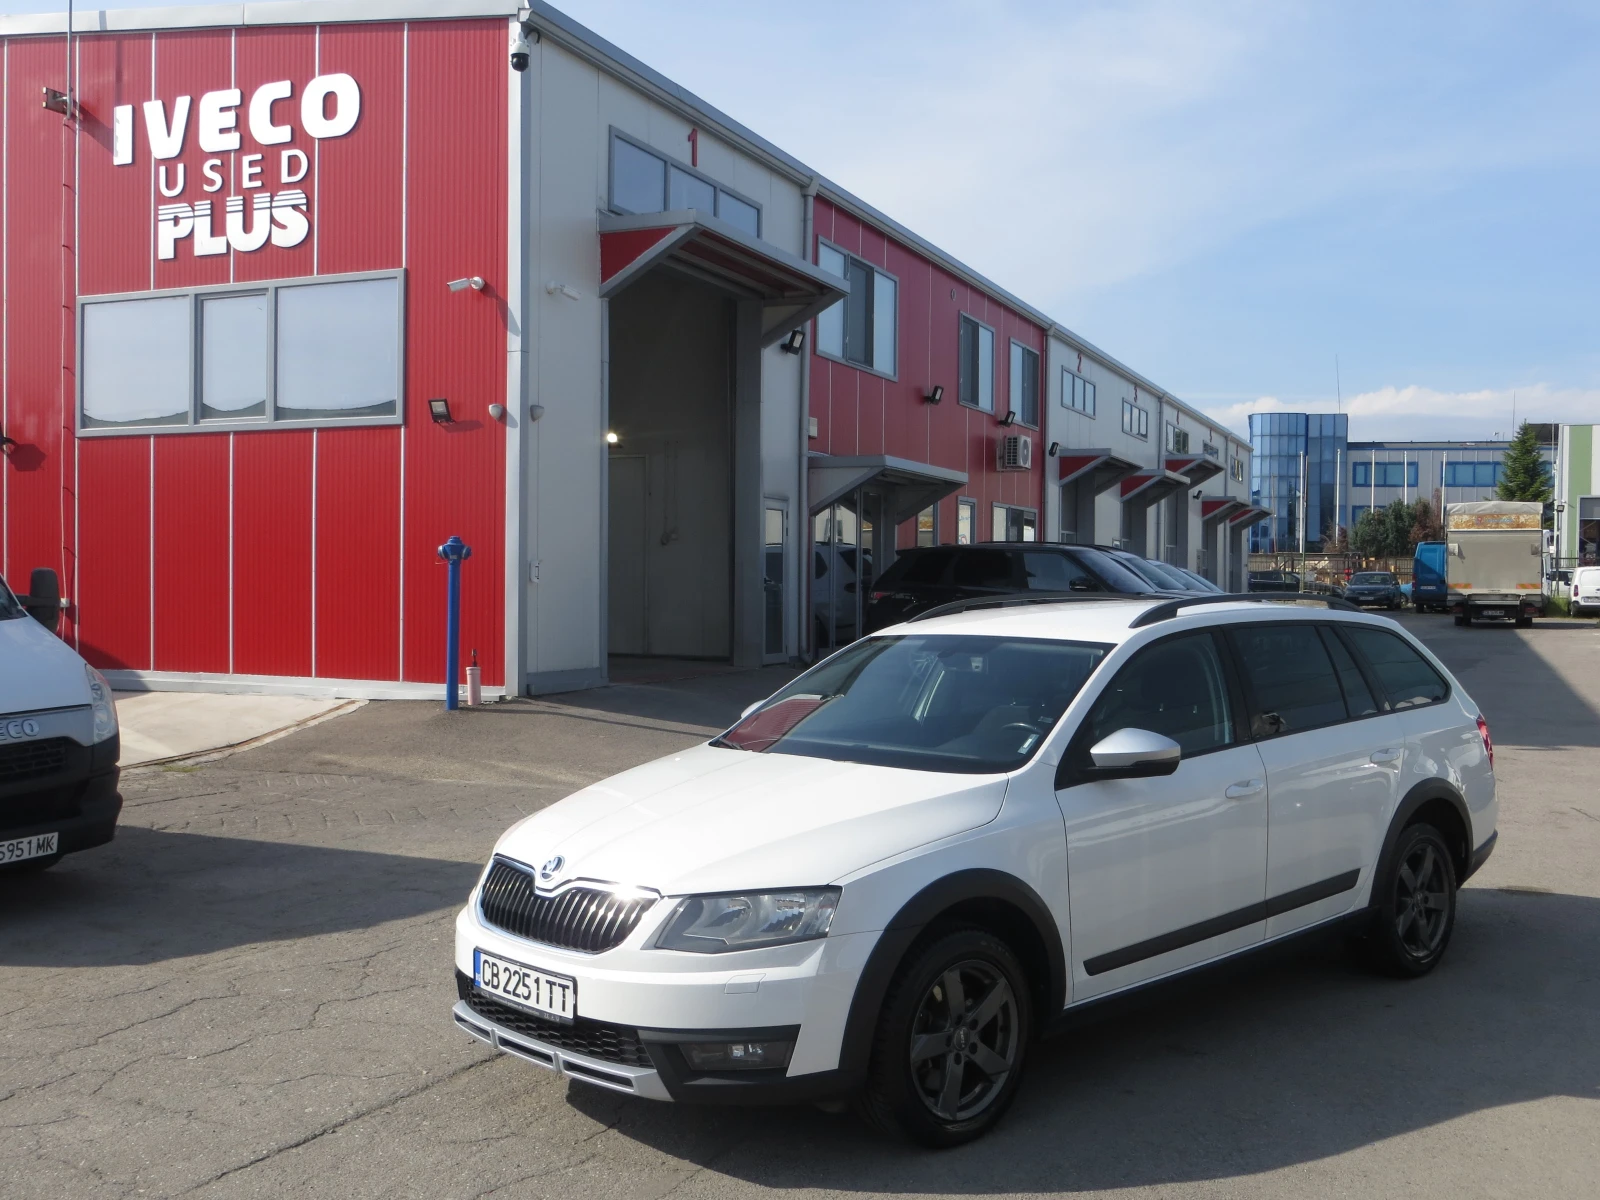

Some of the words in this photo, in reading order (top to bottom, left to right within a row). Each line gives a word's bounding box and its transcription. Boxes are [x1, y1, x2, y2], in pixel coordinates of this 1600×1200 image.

[113, 73, 360, 165] IVECO
[159, 149, 309, 197] USED
[688, 128, 697, 168] 1
[158, 189, 309, 260] PLUS
[36, 835, 55, 855] MK
[482, 959, 500, 990] CB
[502, 966, 540, 1005] 2251
[545, 979, 570, 1013] TT
